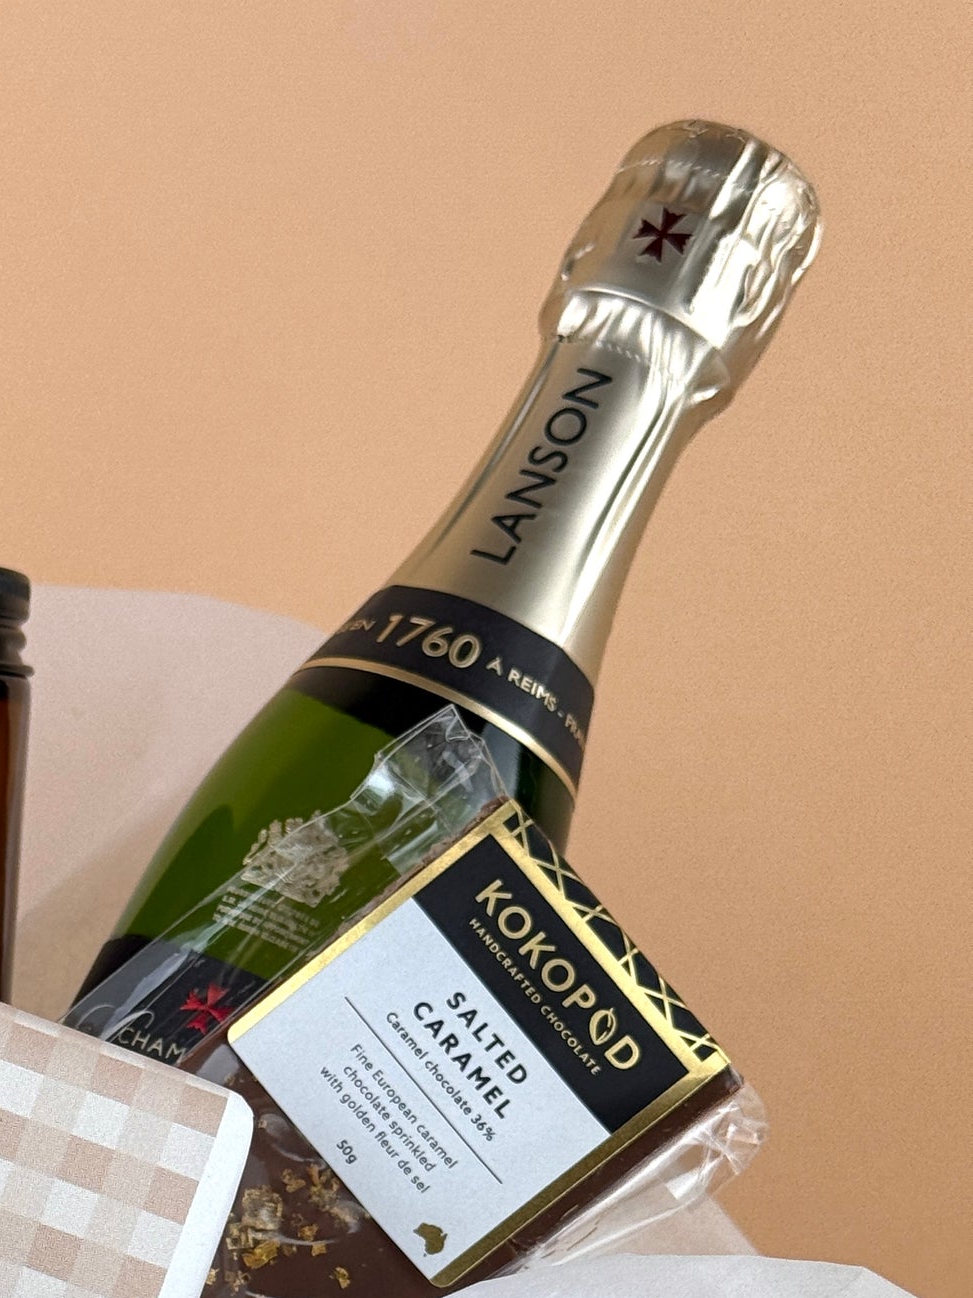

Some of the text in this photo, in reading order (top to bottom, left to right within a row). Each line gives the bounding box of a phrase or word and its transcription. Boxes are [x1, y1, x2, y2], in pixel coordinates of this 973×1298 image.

[469, 367, 613, 566] LANSON
[376, 613, 483, 669] 1760
[508, 668, 557, 713] REIMS
[445, 991, 528, 1085] SALTED
[469, 918, 602, 1076] HANDCRAFTED CHOCOLATE
[343, 1065, 436, 1172] chocolate sprinkled
[350, 1043, 458, 1169] Fine European caramel
[386, 1012, 497, 1142] Caramel chocolate 36%
[413, 1001, 511, 1120] CARAMEL
[320, 1065, 431, 1194] with golden fleur de sel
[336, 1139, 358, 1165] 50g
